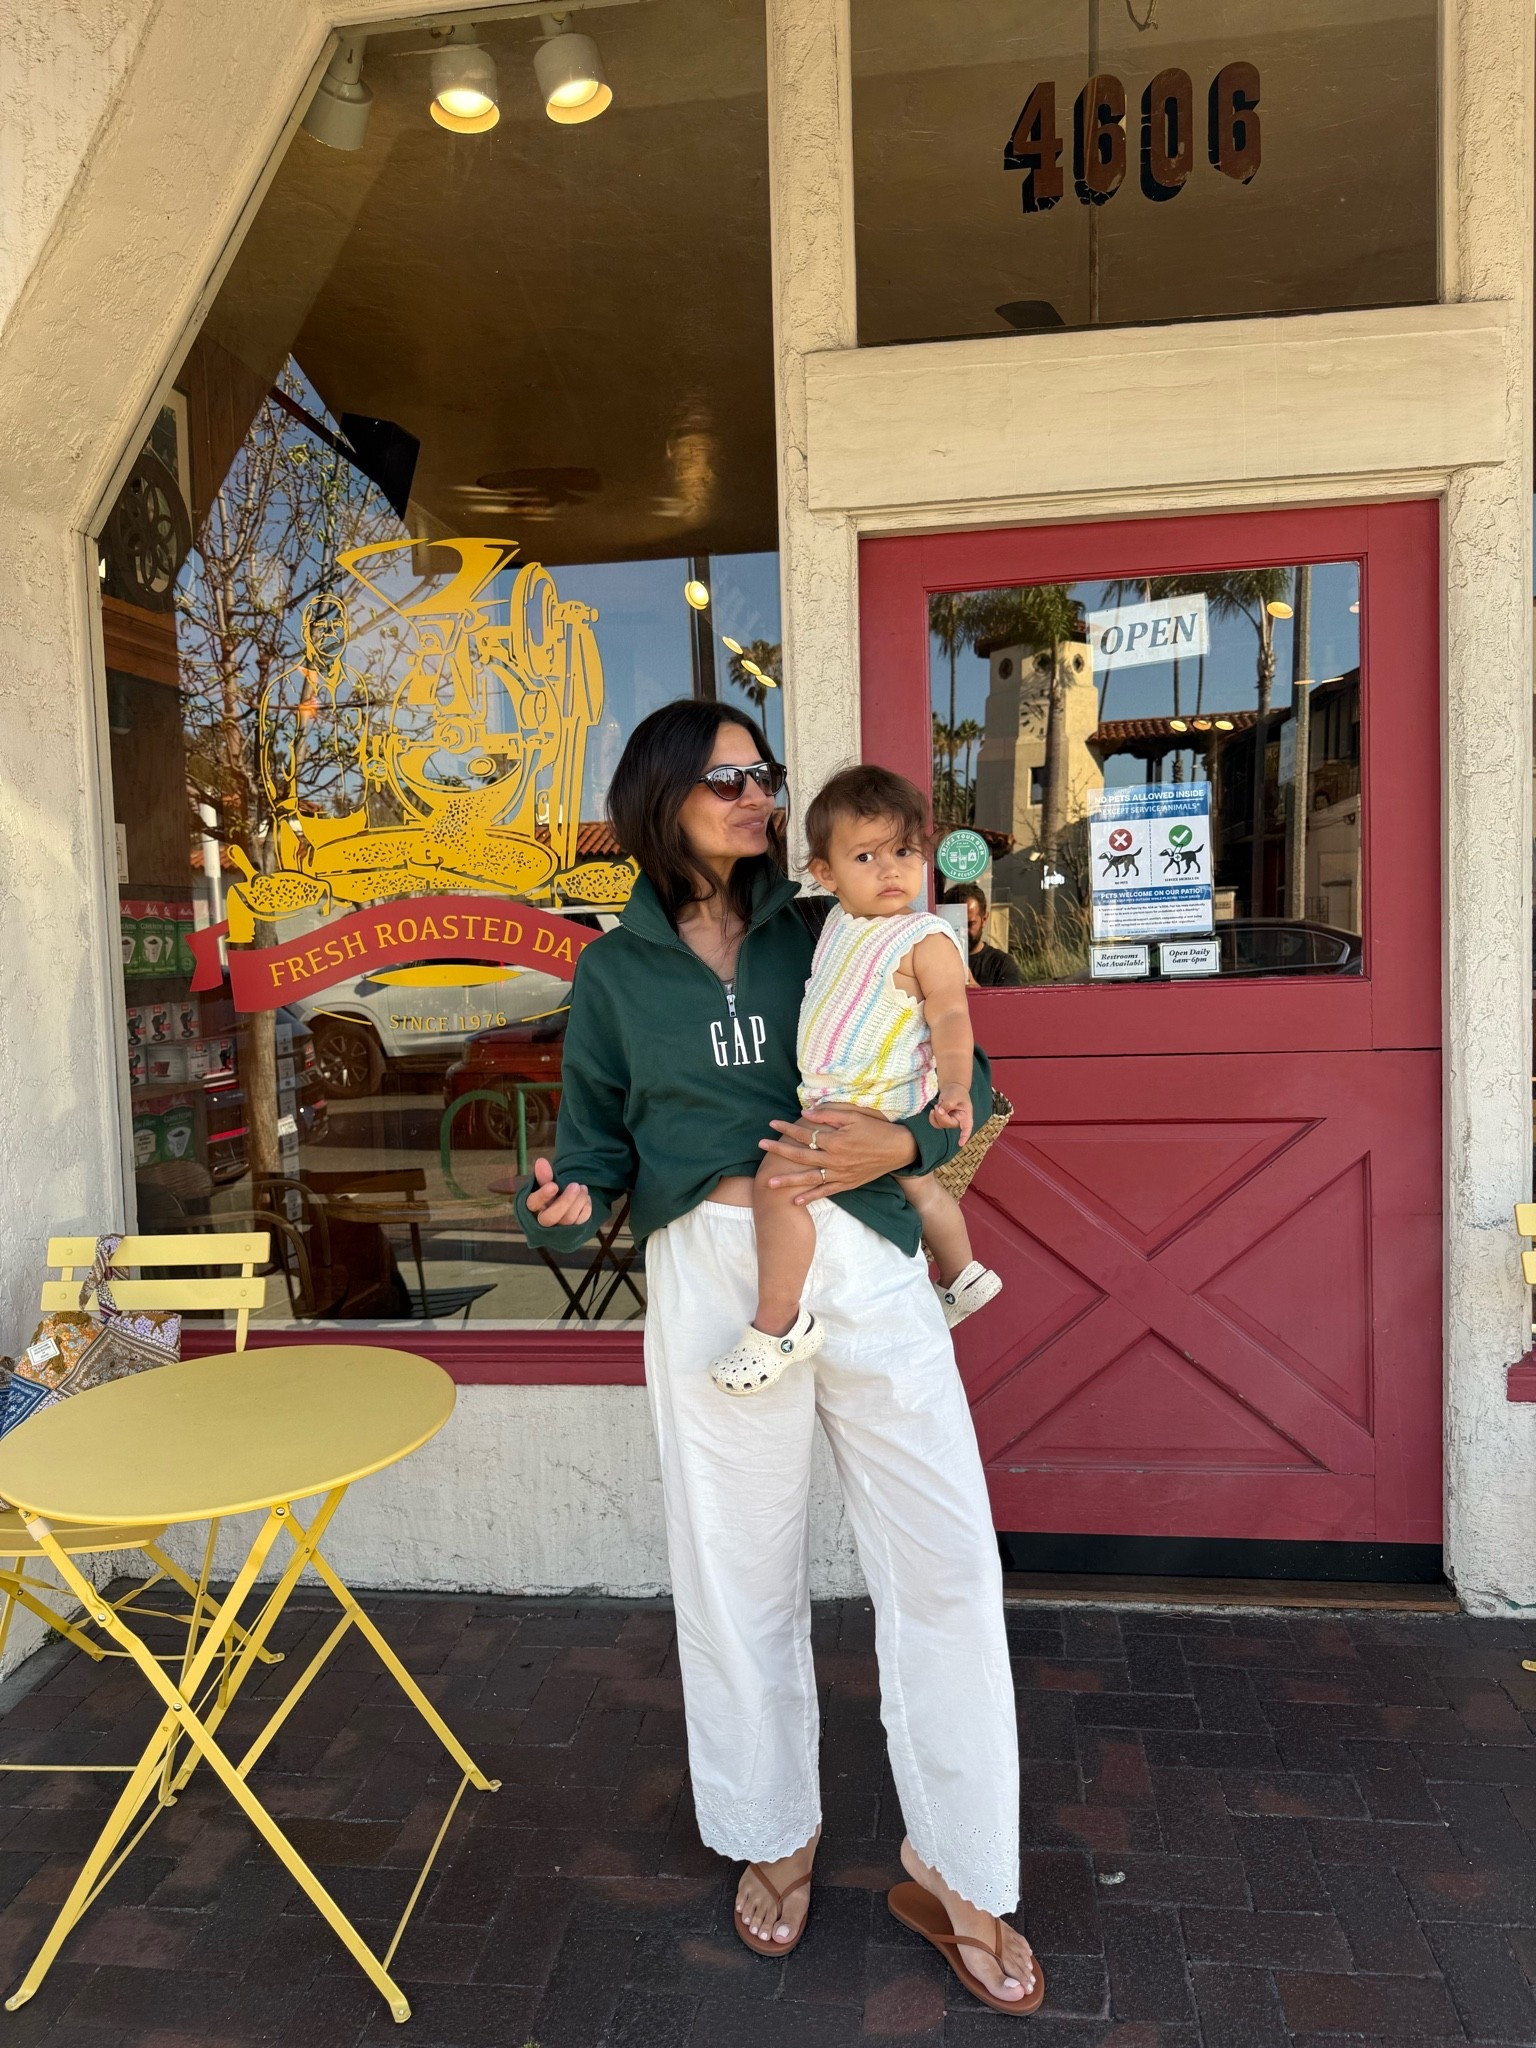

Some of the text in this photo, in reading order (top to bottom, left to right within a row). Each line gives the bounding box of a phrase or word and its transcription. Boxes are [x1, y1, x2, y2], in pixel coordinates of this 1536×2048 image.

[1003, 61, 1261, 214] 4606
[1100, 613, 1198, 655] OPEN
[1095, 789, 1205, 804] NO PETS ALLOWED INSIDE
[1131, 805, 1160, 814] SERVICE
[1119, 890, 1153, 898] WELCOME
[1181, 887, 1203, 895] PATIO!
[268, 915, 588, 988] FRESH ROASTED DA
[1101, 952, 1139, 960] Restrooms
[1169, 948, 1211, 957] Open Daily
[1096, 959, 1145, 968] Not Available
[1172, 956, 1208, 965] 6am-6pm
[389, 1011, 508, 1032] SINCE 1976
[710, 1015, 767, 1067] GAP
